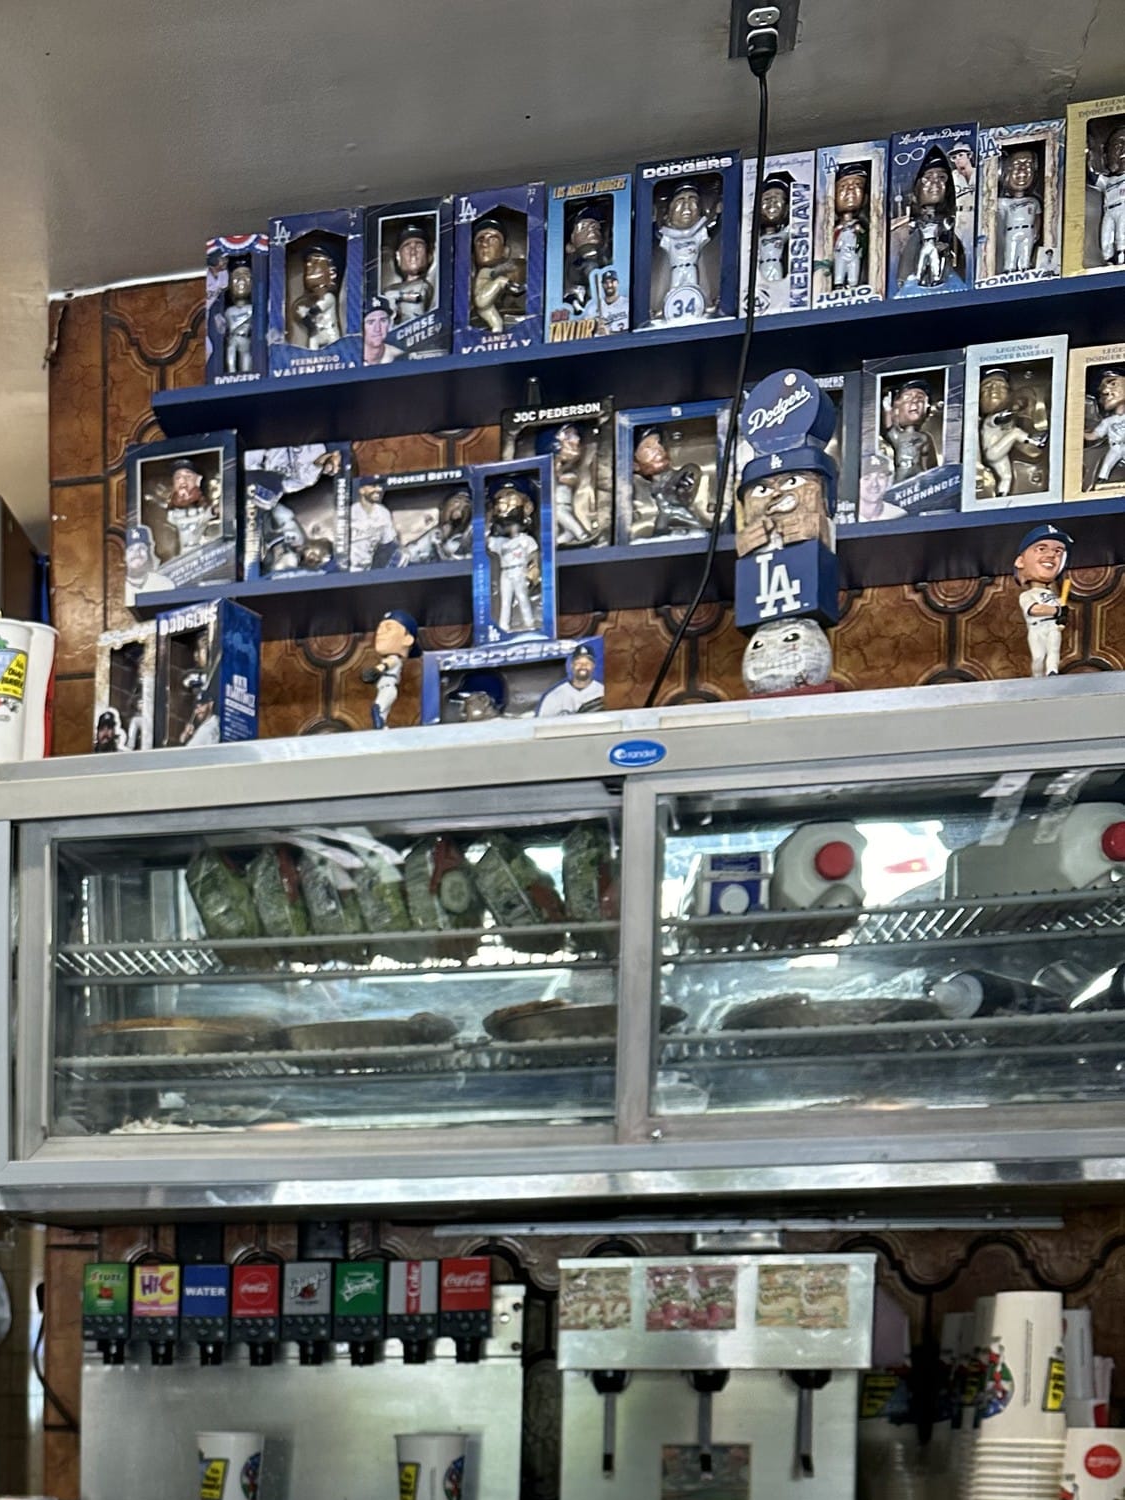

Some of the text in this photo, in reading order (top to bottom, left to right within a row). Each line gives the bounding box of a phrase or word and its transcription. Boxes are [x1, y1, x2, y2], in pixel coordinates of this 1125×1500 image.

[941, 128, 971, 142] Dodgers
[979, 134, 1001, 159] LA
[643, 157, 733, 178] DODGERS
[823, 152, 839, 174] LA
[459, 197, 477, 221] LA
[274, 220, 291, 245] LA
[790, 183, 810, 308] KERSHAW
[975, 270, 1042, 289] TOMMY
[817, 286, 871, 302] JULIO
[673, 298, 696, 317] 34
[396, 314, 436, 340] CHASE
[406, 322, 442, 347] UTLEY
[548, 319, 595, 342] TAYLOR
[482, 334, 513, 344] SANDY
[996, 344, 1033, 353] LEGENDS
[290, 355, 340, 366] FERNANDO
[980, 349, 1054, 363] DODGER BASEBALL
[513, 402, 600, 423] JOC PEDERSON
[747, 385, 811, 435] Dodgers
[387, 470, 463, 486] MOOKIE BETTS
[895, 481, 920, 500] KIKÉ
[756, 553, 801, 618] LA
[185, 1287, 225, 1296] WATER
